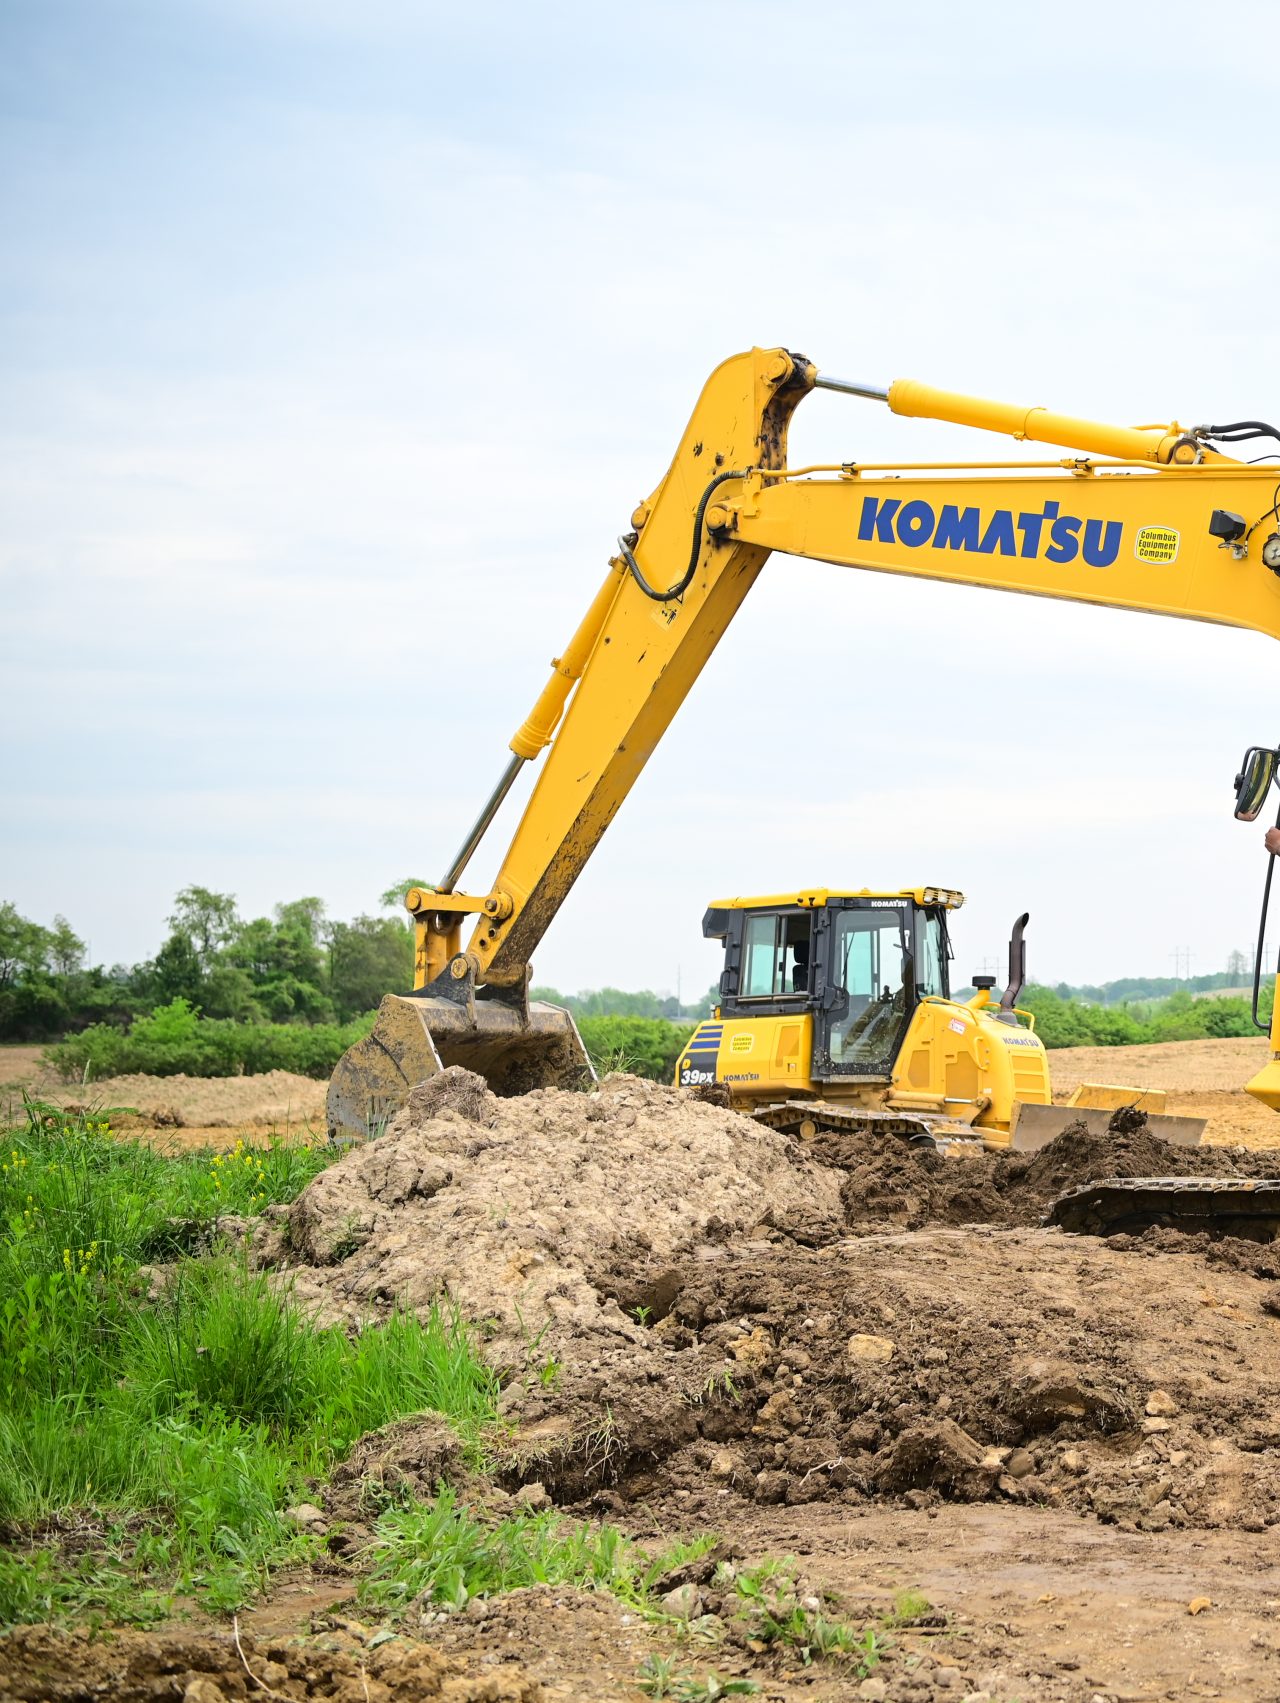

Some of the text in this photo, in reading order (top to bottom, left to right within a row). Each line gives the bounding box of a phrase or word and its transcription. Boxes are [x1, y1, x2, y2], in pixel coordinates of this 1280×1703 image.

[857, 496, 1124, 568] KOMATSU
[1141, 531, 1176, 541] Columbus
[1139, 540, 1176, 550] Equipment
[1140, 549, 1172, 559] Company
[871, 899, 908, 908] KOMATSU
[1003, 1037, 1039, 1047] KOMATSU
[724, 1072, 759, 1081] KOMATSU
